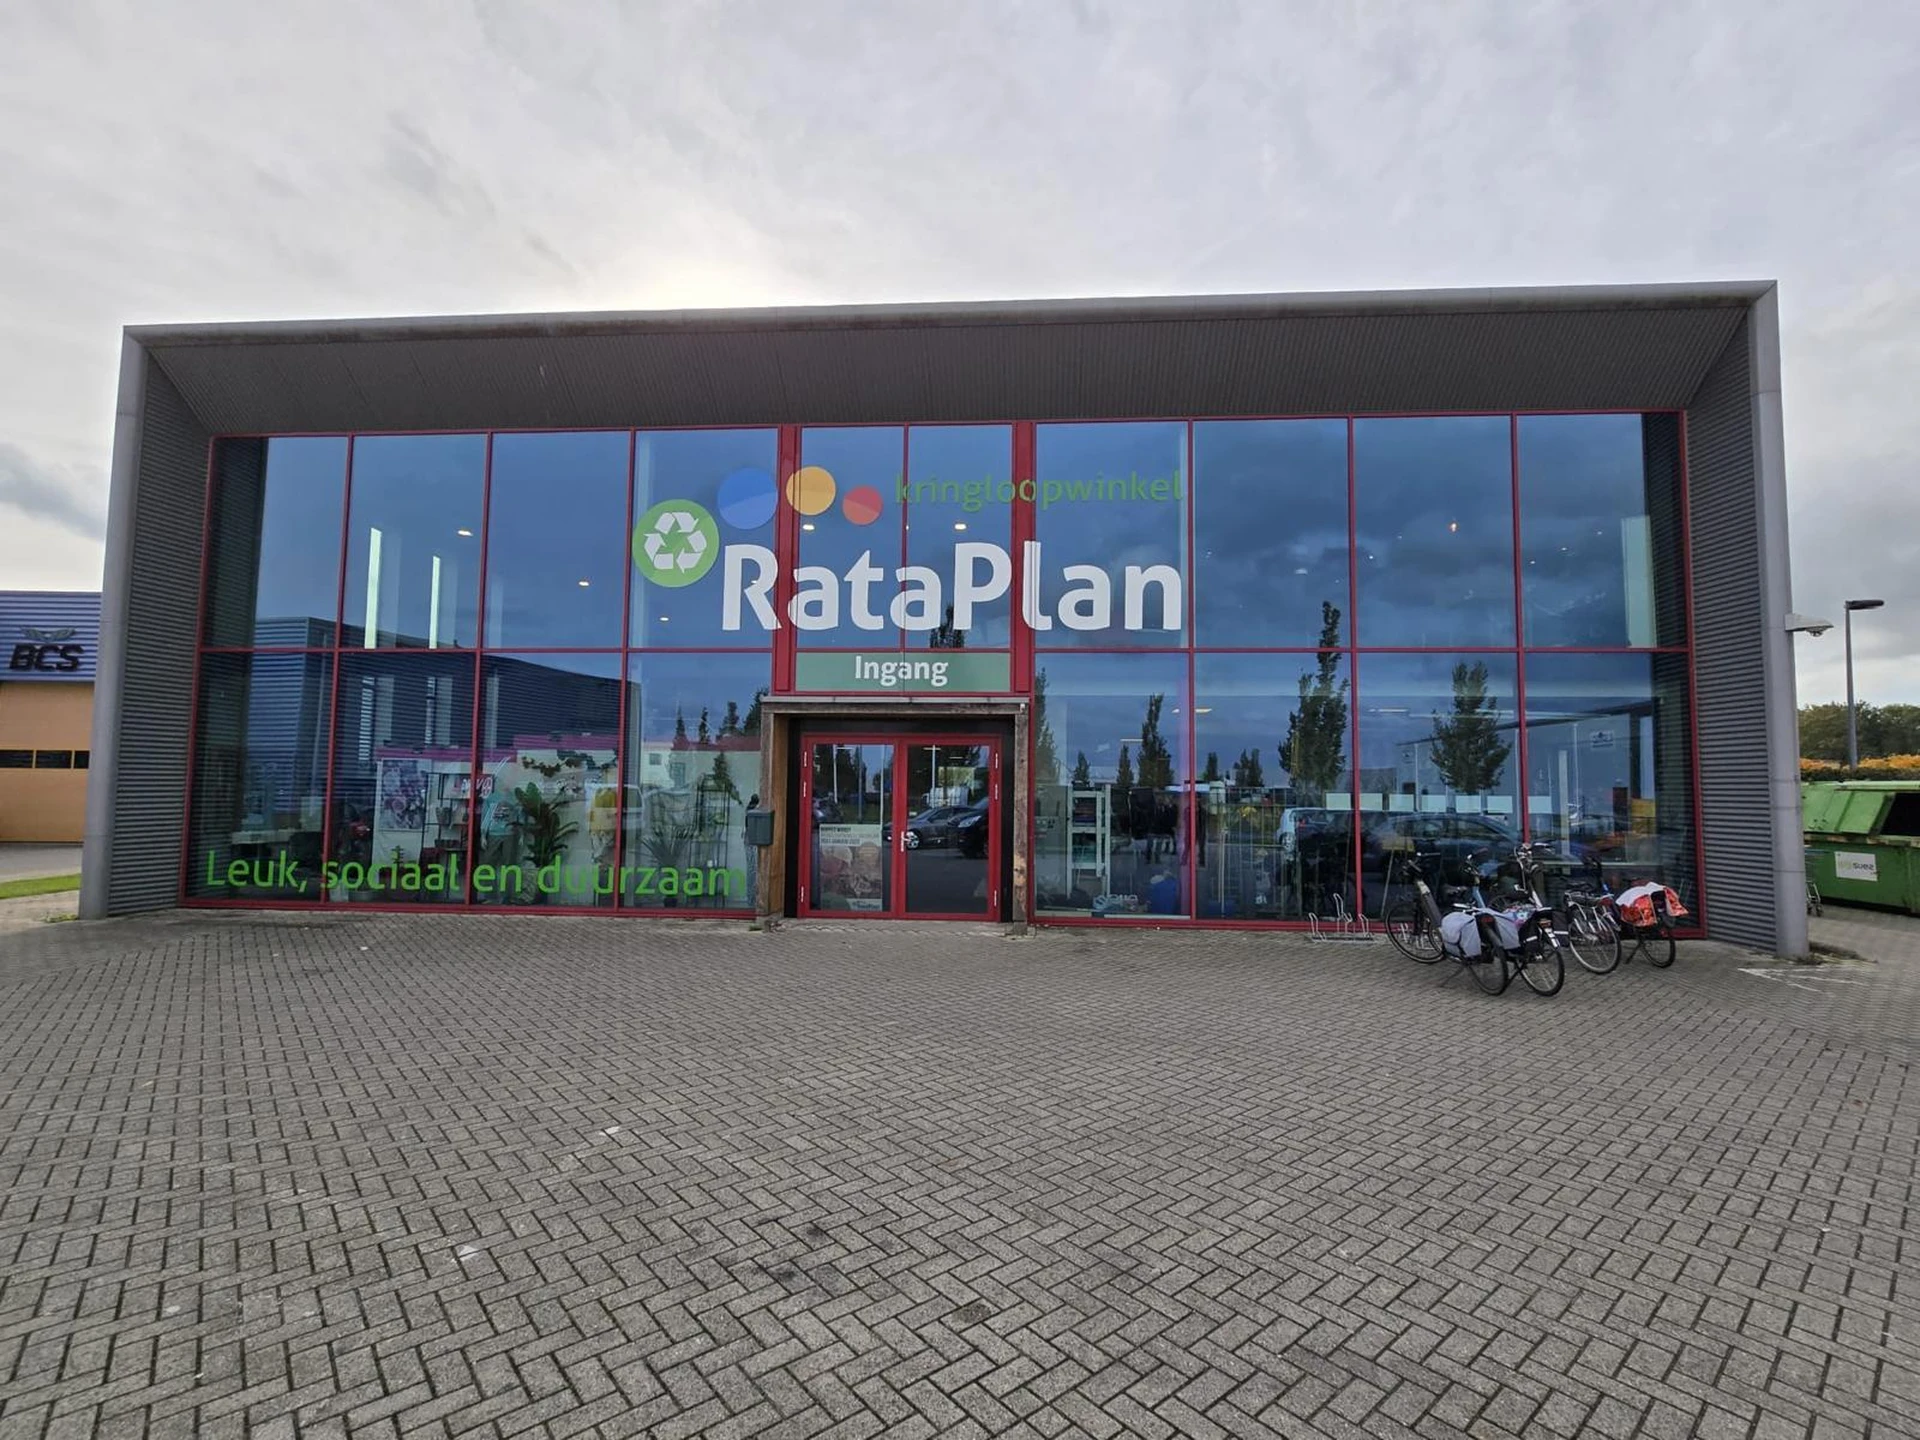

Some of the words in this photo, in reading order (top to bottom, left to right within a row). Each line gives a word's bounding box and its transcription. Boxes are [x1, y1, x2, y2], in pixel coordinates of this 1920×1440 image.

[895, 470, 1184, 512] kringloopwinkel
[722, 540, 1182, 631] RataPlan
[9, 643, 84, 672] BCS
[855, 655, 949, 687] Ingang
[206, 850, 308, 893] Leuk,
[320, 853, 460, 891] sociaal
[472, 863, 522, 893] en
[537, 855, 747, 896] duurzaam
